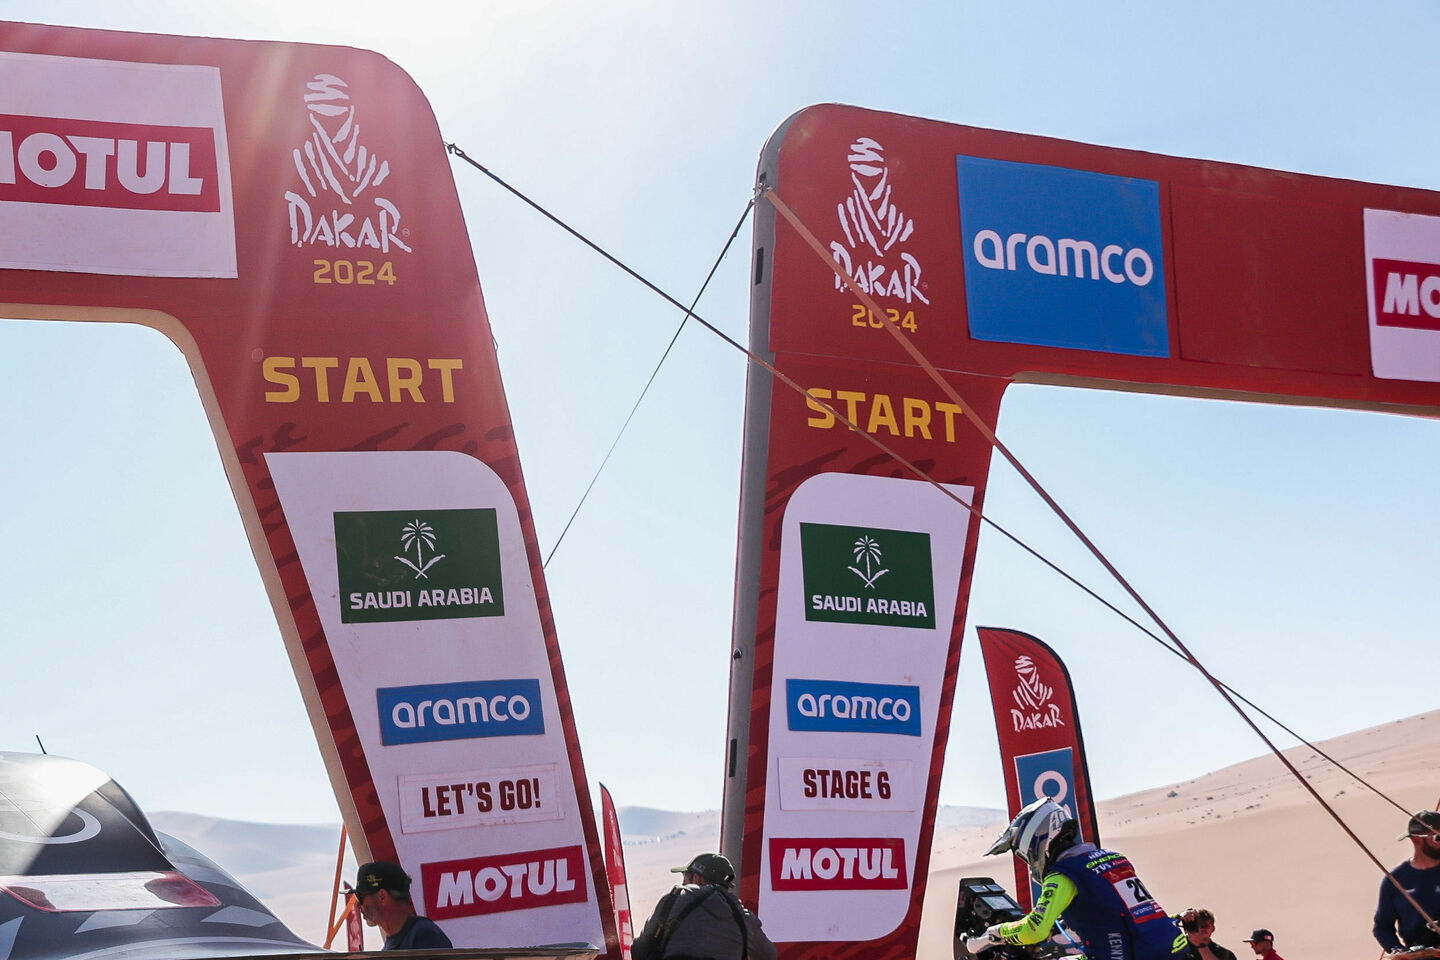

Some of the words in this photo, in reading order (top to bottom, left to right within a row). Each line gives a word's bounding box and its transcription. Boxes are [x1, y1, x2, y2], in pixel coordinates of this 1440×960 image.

[285, 191, 412, 253] DAKAR
[313, 259, 396, 285] 2024
[830, 241, 929, 304] DAKAR
[974, 229, 1153, 287] aramco
[263, 356, 462, 403] START
[806, 387, 964, 443] START
[350, 591, 411, 610] SAUDI
[418, 586, 494, 607] ARABIA
[812, 595, 861, 613] SAUDI
[867, 599, 928, 618] ARABIA
[392, 694, 531, 728] aramco
[797, 693, 911, 722] aramco
[1010, 703, 1064, 733] DAKAR
[421, 781, 493, 818] LET'S
[498, 777, 541, 812] GO!
[803, 769, 872, 800] STAGE
[877, 771, 891, 799] 6
[780, 847, 899, 880] MOTUL
[436, 857, 577, 909] MOTUL
[1108, 932, 1124, 960] KENNY
